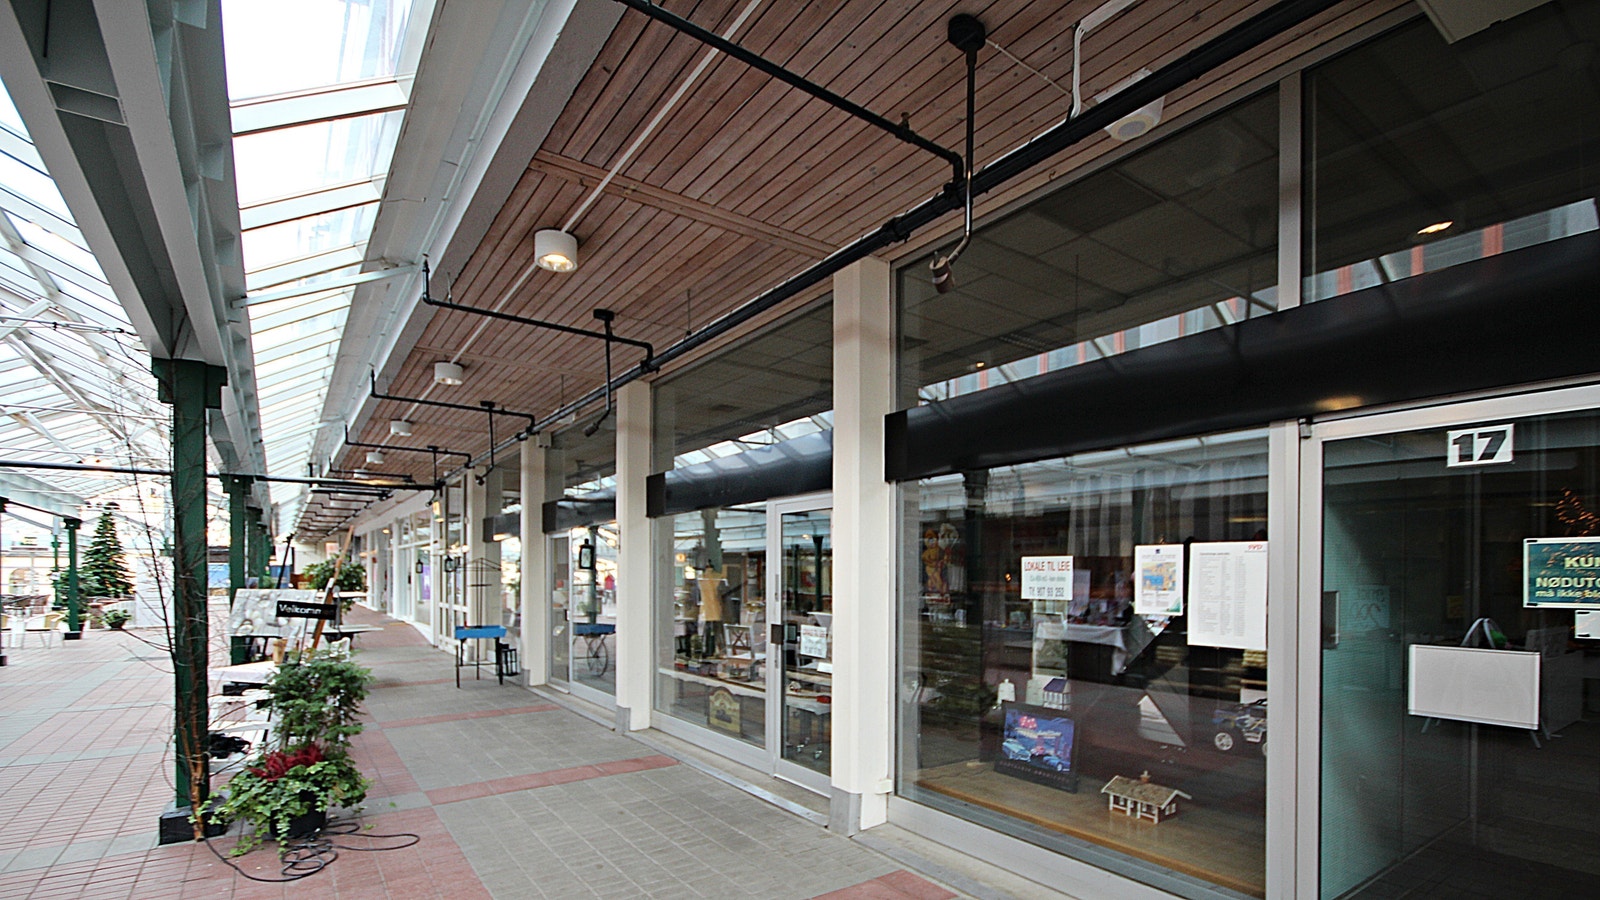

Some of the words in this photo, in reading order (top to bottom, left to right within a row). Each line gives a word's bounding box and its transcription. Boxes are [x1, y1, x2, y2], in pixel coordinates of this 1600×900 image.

[1452, 430, 1507, 463] 17
[1535, 589, 1554, 598] må
[1557, 589, 1582, 598] ikke
